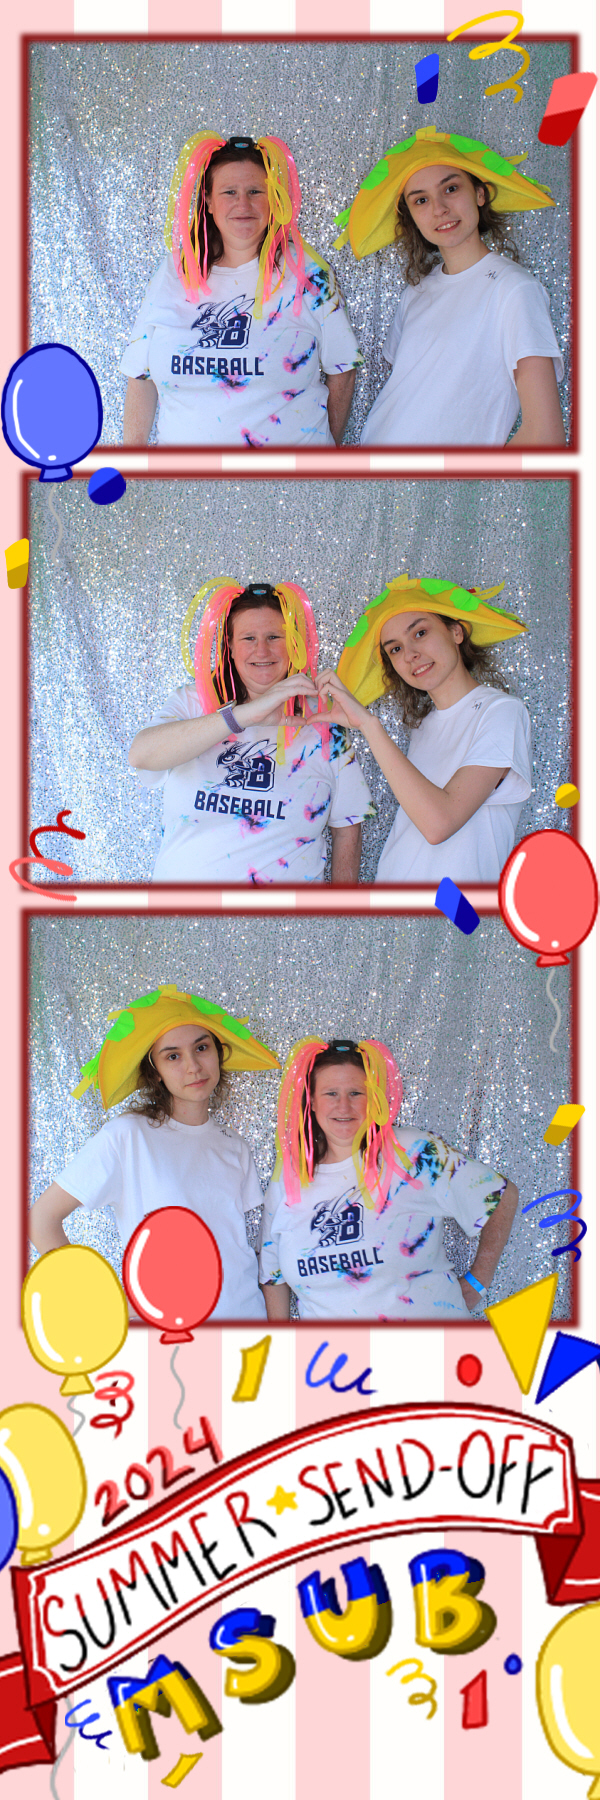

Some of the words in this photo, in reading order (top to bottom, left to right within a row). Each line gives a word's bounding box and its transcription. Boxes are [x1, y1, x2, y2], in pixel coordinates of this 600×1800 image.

[170, 354, 265, 376] BASEBALL
[194, 790, 286, 821] BASEBALL
[297, 1246, 385, 1278] BASEBALL
